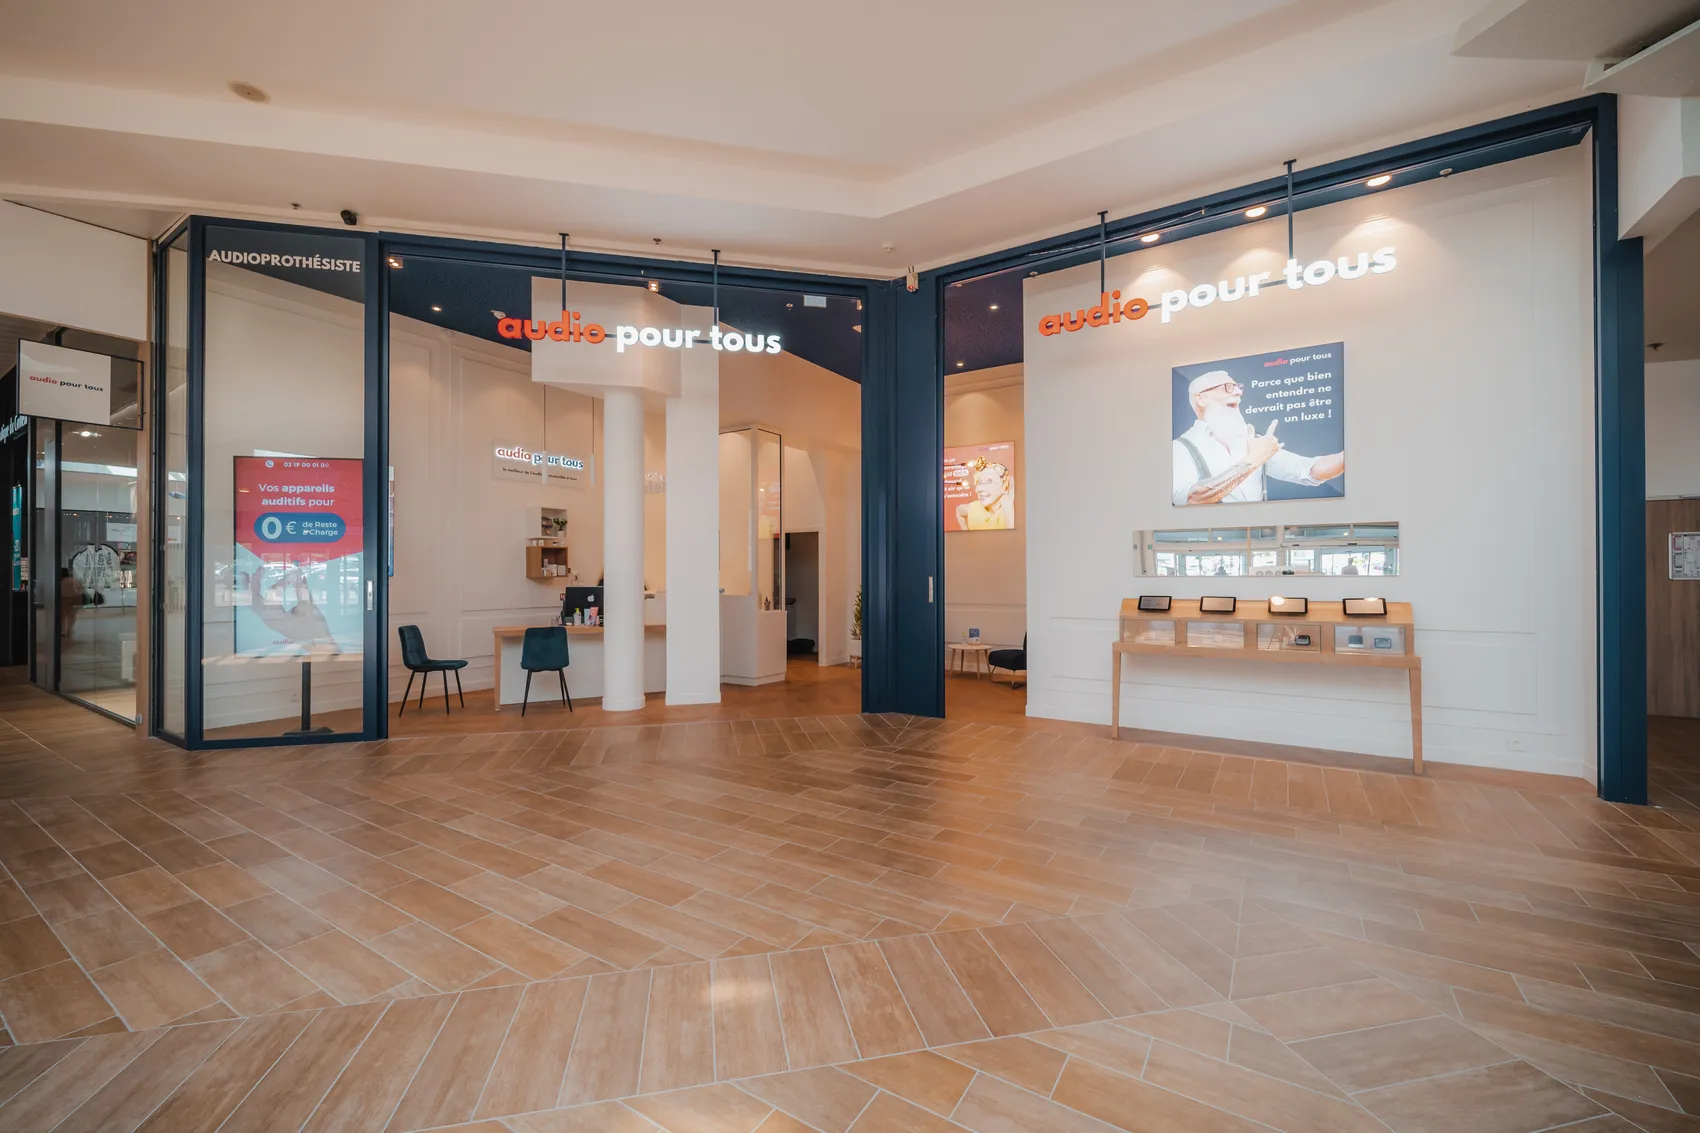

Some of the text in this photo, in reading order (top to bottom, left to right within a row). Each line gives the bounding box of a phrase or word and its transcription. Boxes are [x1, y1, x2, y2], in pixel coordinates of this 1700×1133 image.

[208, 249, 361, 273] AUDIOPROTHÉSISTE
[1038, 246, 1398, 337] audio pour tous
[497, 310, 782, 354] audio pour tous
[1263, 352, 1332, 368] audio pour tous
[29, 375, 104, 392] audio pour tous
[1251, 371, 1332, 388] Parce que bien
[1265, 385, 1332, 399] entendre ne
[1245, 398, 1332, 414] devrait pas être
[1284, 409, 1332, 423] un luxe !
[496, 446, 584, 469] audio pur tous
[258, 483, 335, 494] Vos appareils
[261, 496, 335, 507] auditifs pour
[261, 516, 297, 540] 0 €
[309, 528, 339, 537] Charge
